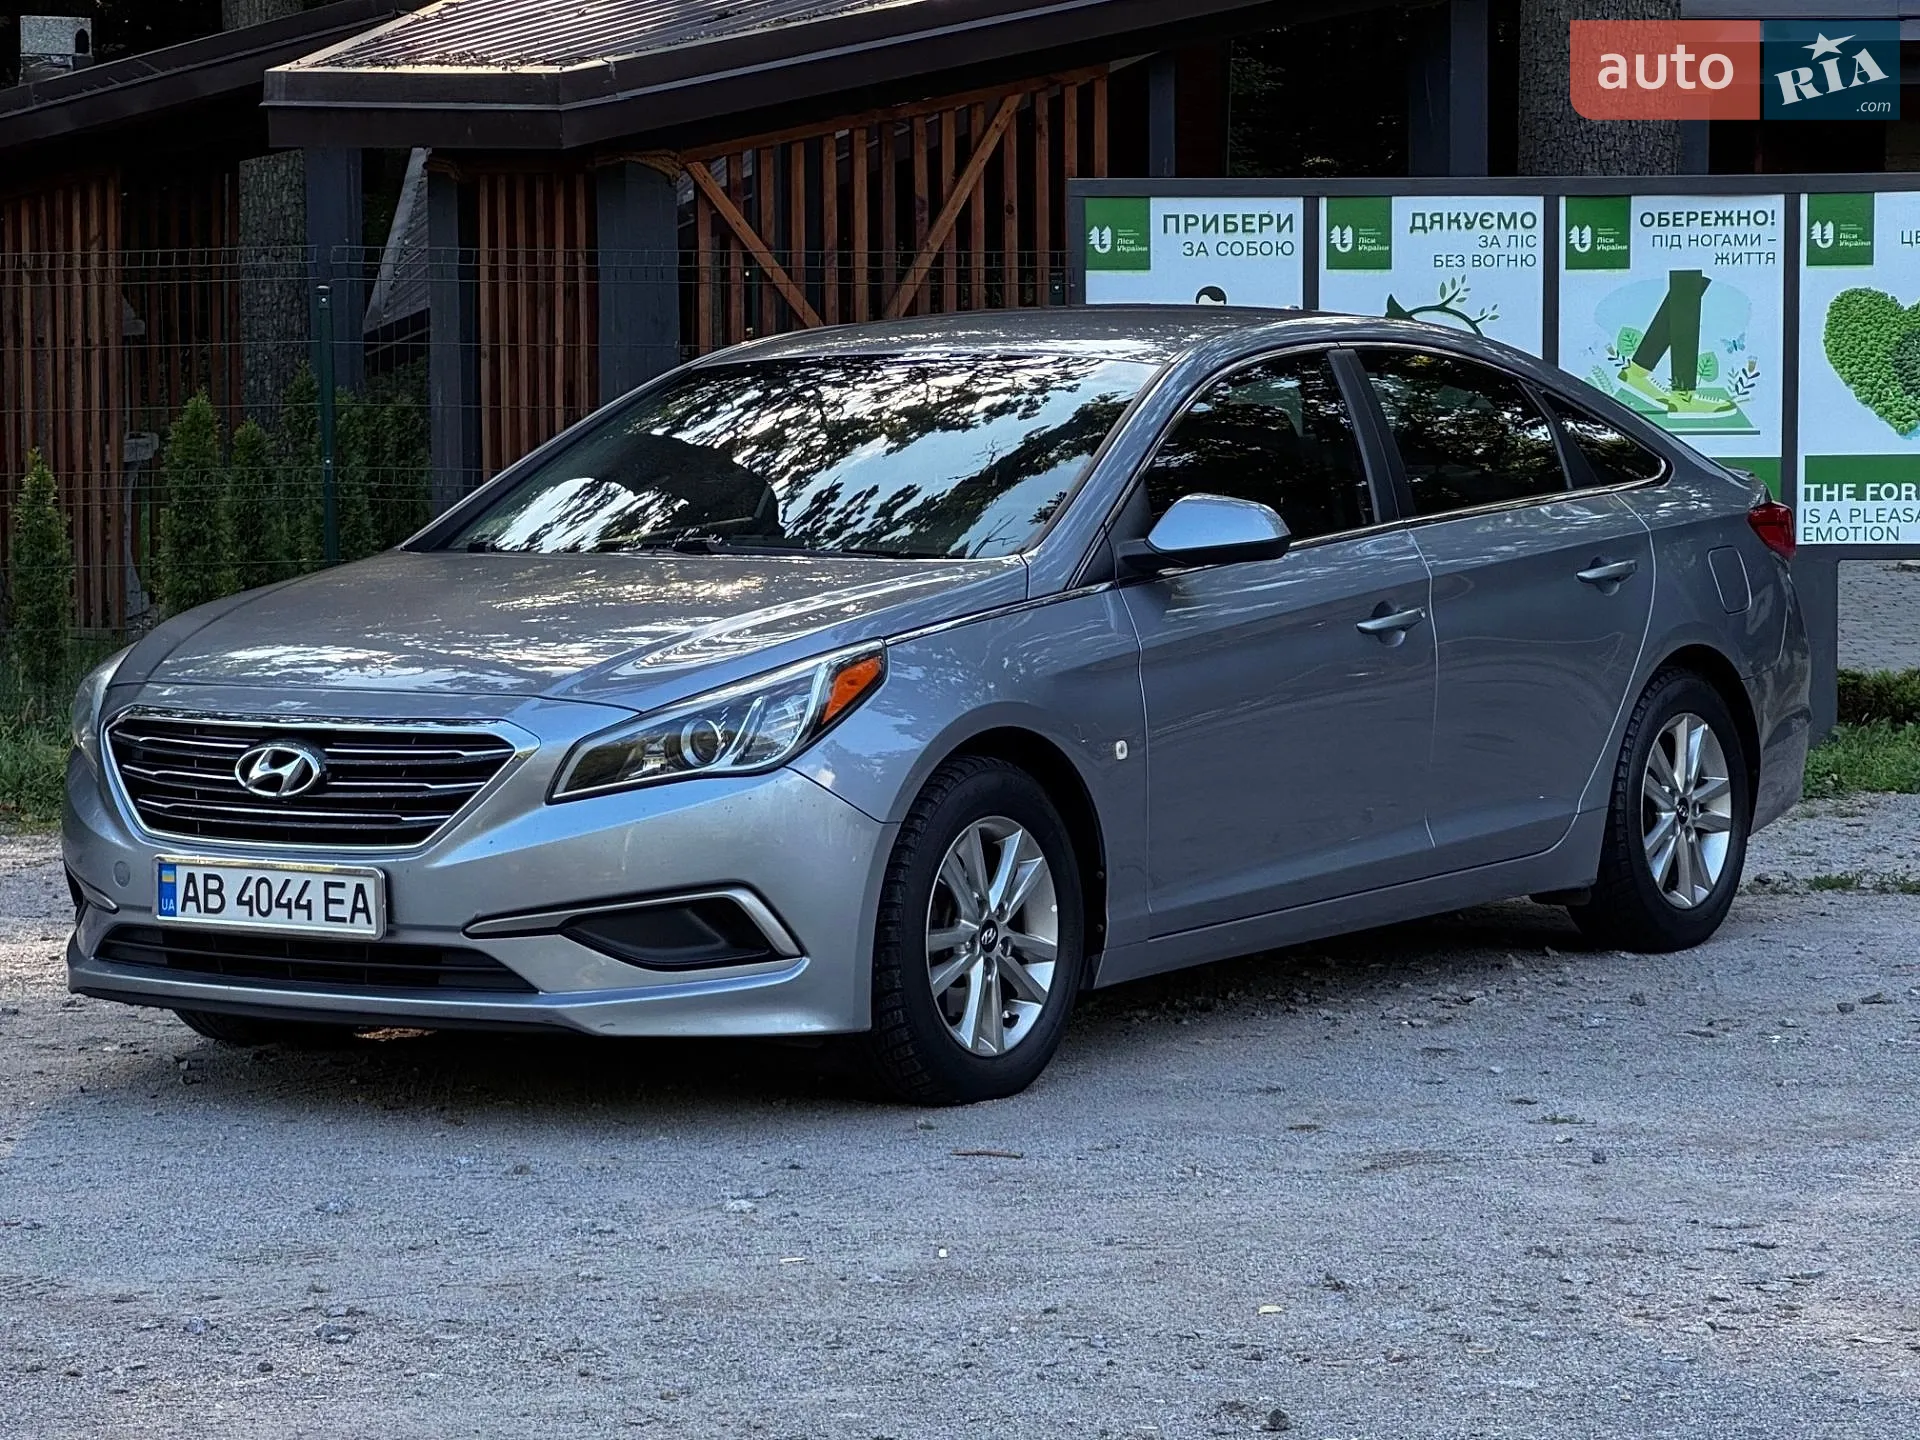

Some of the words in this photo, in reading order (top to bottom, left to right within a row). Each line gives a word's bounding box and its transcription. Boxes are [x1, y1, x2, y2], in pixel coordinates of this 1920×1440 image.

[1163, 213, 1295, 235] ПРИБЕРИ
[1409, 212, 1537, 235] ДЯКУЄМО
[1640, 209, 1776, 228] ОБЕРЕЖНО!
[1182, 241, 1210, 257] ЗА
[1216, 241, 1295, 257] СОБОЮ
[1478, 235, 1501, 248] ЗА
[1507, 235, 1537, 248] ЛІС
[1652, 234, 1682, 249] ПІД
[1688, 233, 1761, 248] НОГАМИ
[1433, 254, 1466, 268] БЕЗ
[1471, 254, 1537, 268] ВОГНЮ
[1714, 252, 1776, 265] ЖИТТЯ
[1804, 483, 1857, 502] THE
[1803, 508, 1820, 524] IS
[1827, 508, 1841, 524] A
[1803, 526, 1900, 542] EMOTION
[161, 898, 175, 912] UA
[180, 872, 226, 915] AB
[236, 875, 313, 922] 4044
[323, 881, 373, 925] EA
